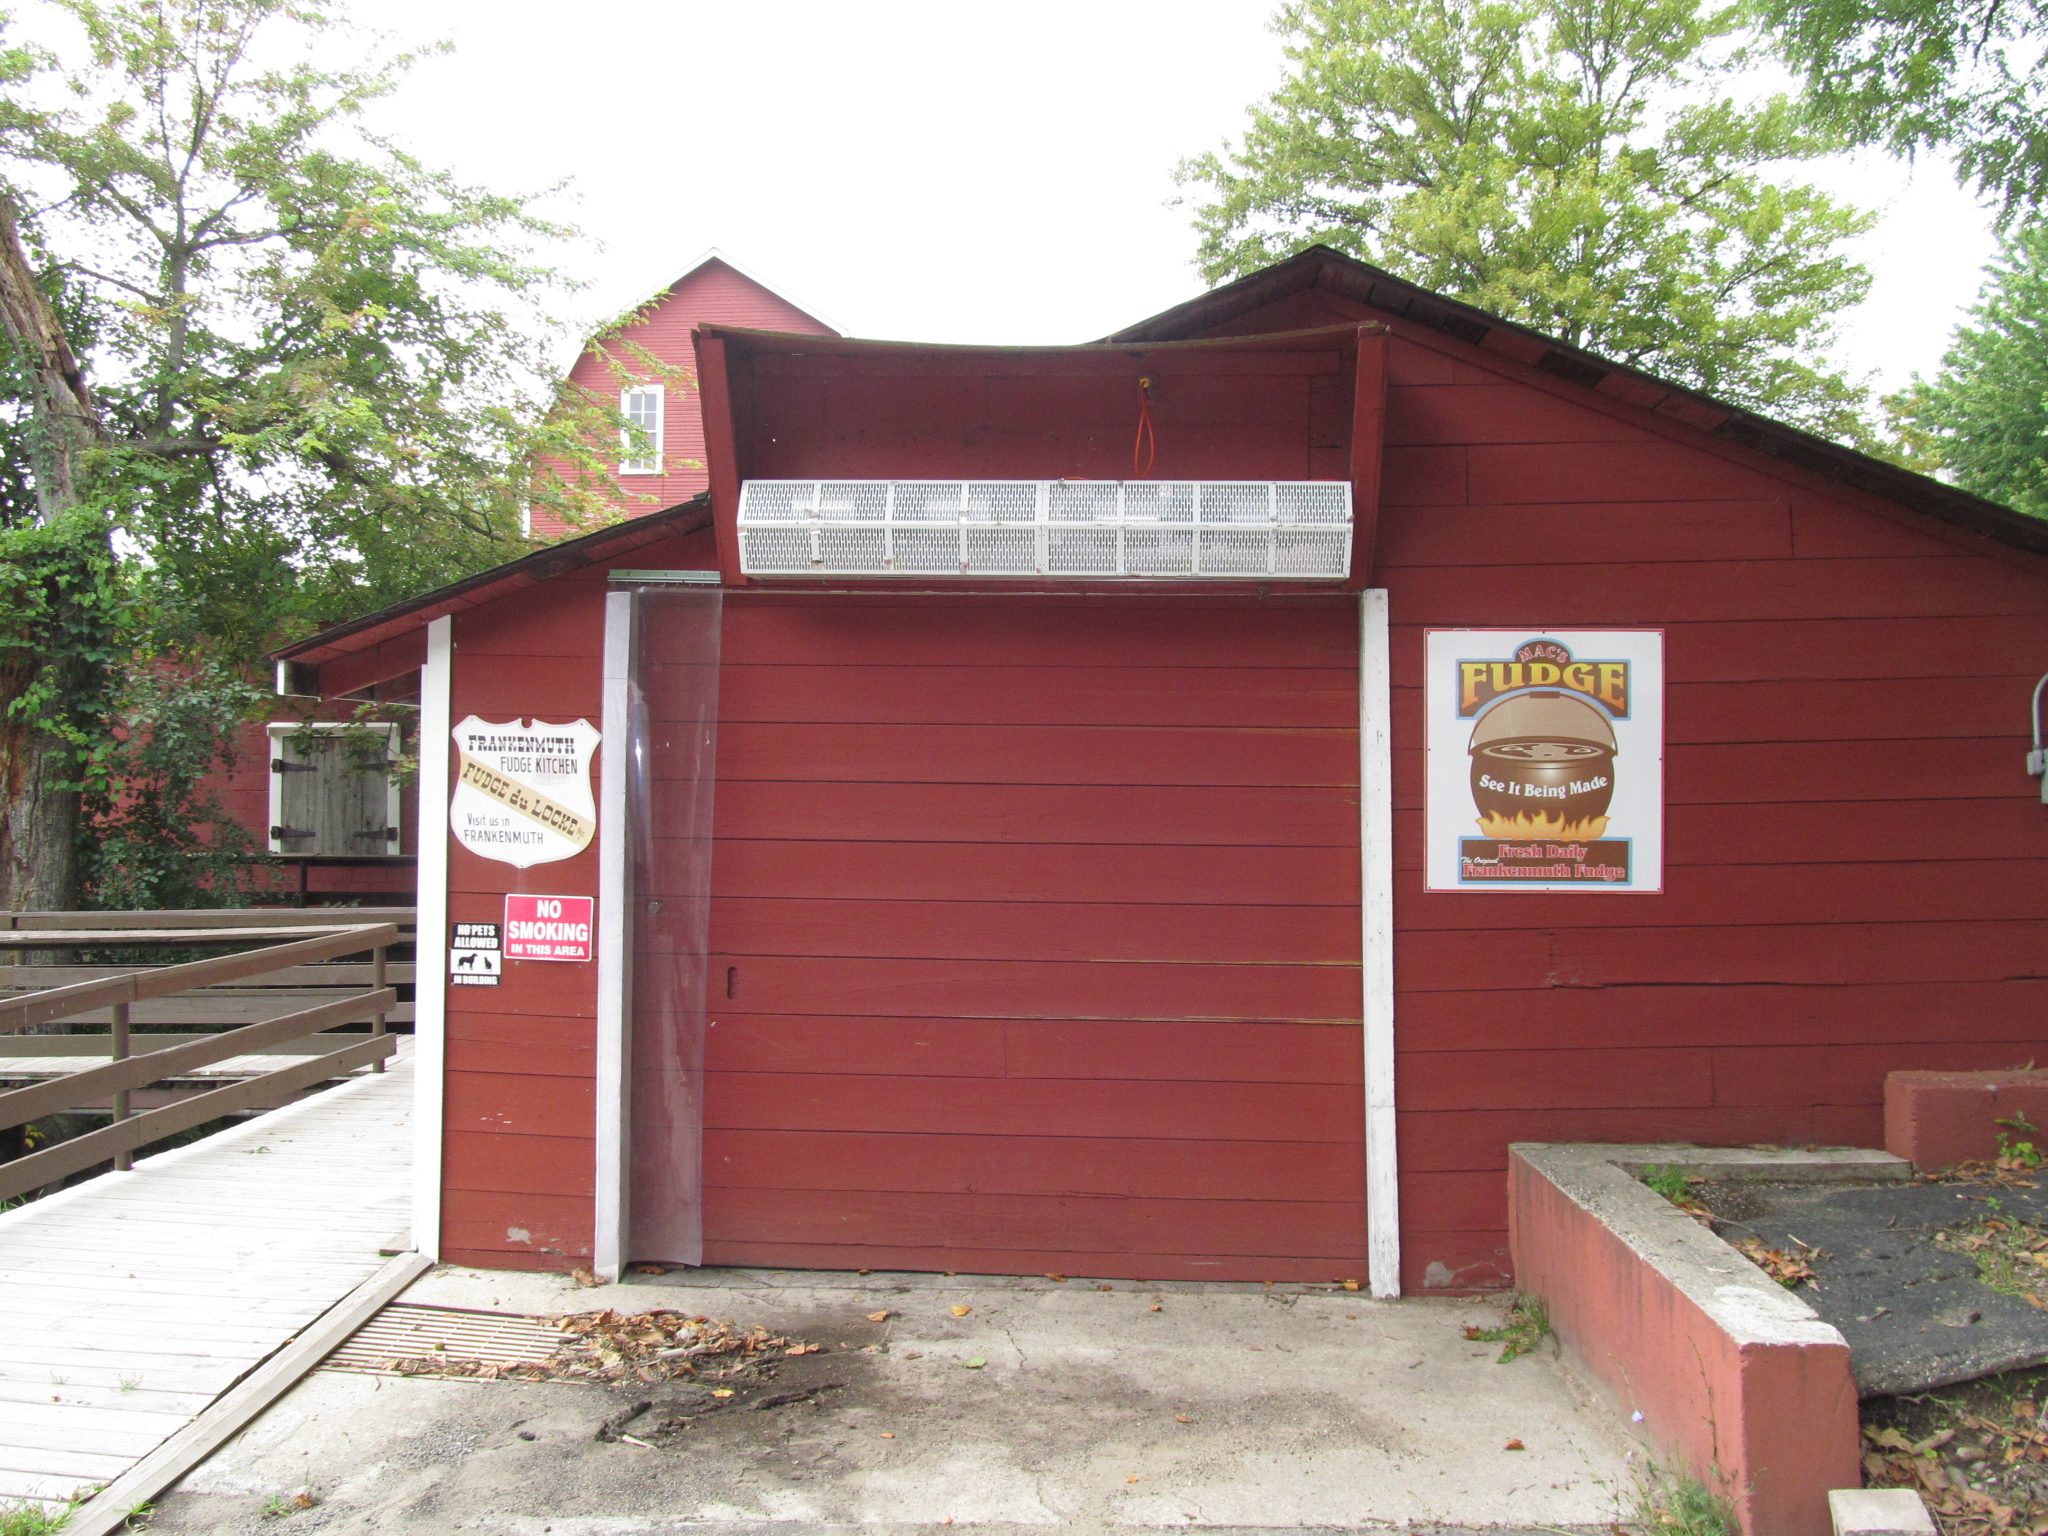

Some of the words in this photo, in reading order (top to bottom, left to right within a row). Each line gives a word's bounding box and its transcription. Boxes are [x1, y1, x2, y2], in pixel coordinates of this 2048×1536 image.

[1518, 644, 1568, 663] MAC'S
[1461, 662, 1625, 710] FUDGE
[468, 735, 575, 754] FRANKENMUTH
[500, 757, 532, 773] FUDGE
[536, 758, 578, 774] KITCHEN
[1478, 775, 1504, 793] See
[1508, 781, 1521, 795] It
[1524, 783, 1566, 799] Being
[1569, 775, 1608, 794] Made
[462, 762, 510, 798] FUDGE
[510, 789, 528, 810] du
[531, 799, 578, 835] LOCKE
[467, 813, 486, 826] Visit
[490, 817, 499, 826] us
[502, 816, 510, 826] in
[464, 829, 544, 844] FRANKENMUTH
[1498, 844, 1543, 858] Fresh
[1546, 844, 1588, 861] Daily
[1462, 863, 1571, 878] Frankenmuth
[1574, 863, 1625, 881] Fudge
[536, 900, 562, 919] NO
[457, 924, 471, 936] NO
[472, 924, 495, 936] PETS
[509, 921, 588, 942] SMOKING
[454, 937, 498, 949] ALLOWED
[511, 944, 523, 954] IN
[526, 944, 551, 955] THIS
[554, 945, 584, 956] AREA
[454, 975, 463, 984] IN
[463, 975, 498, 985] BUILDING
